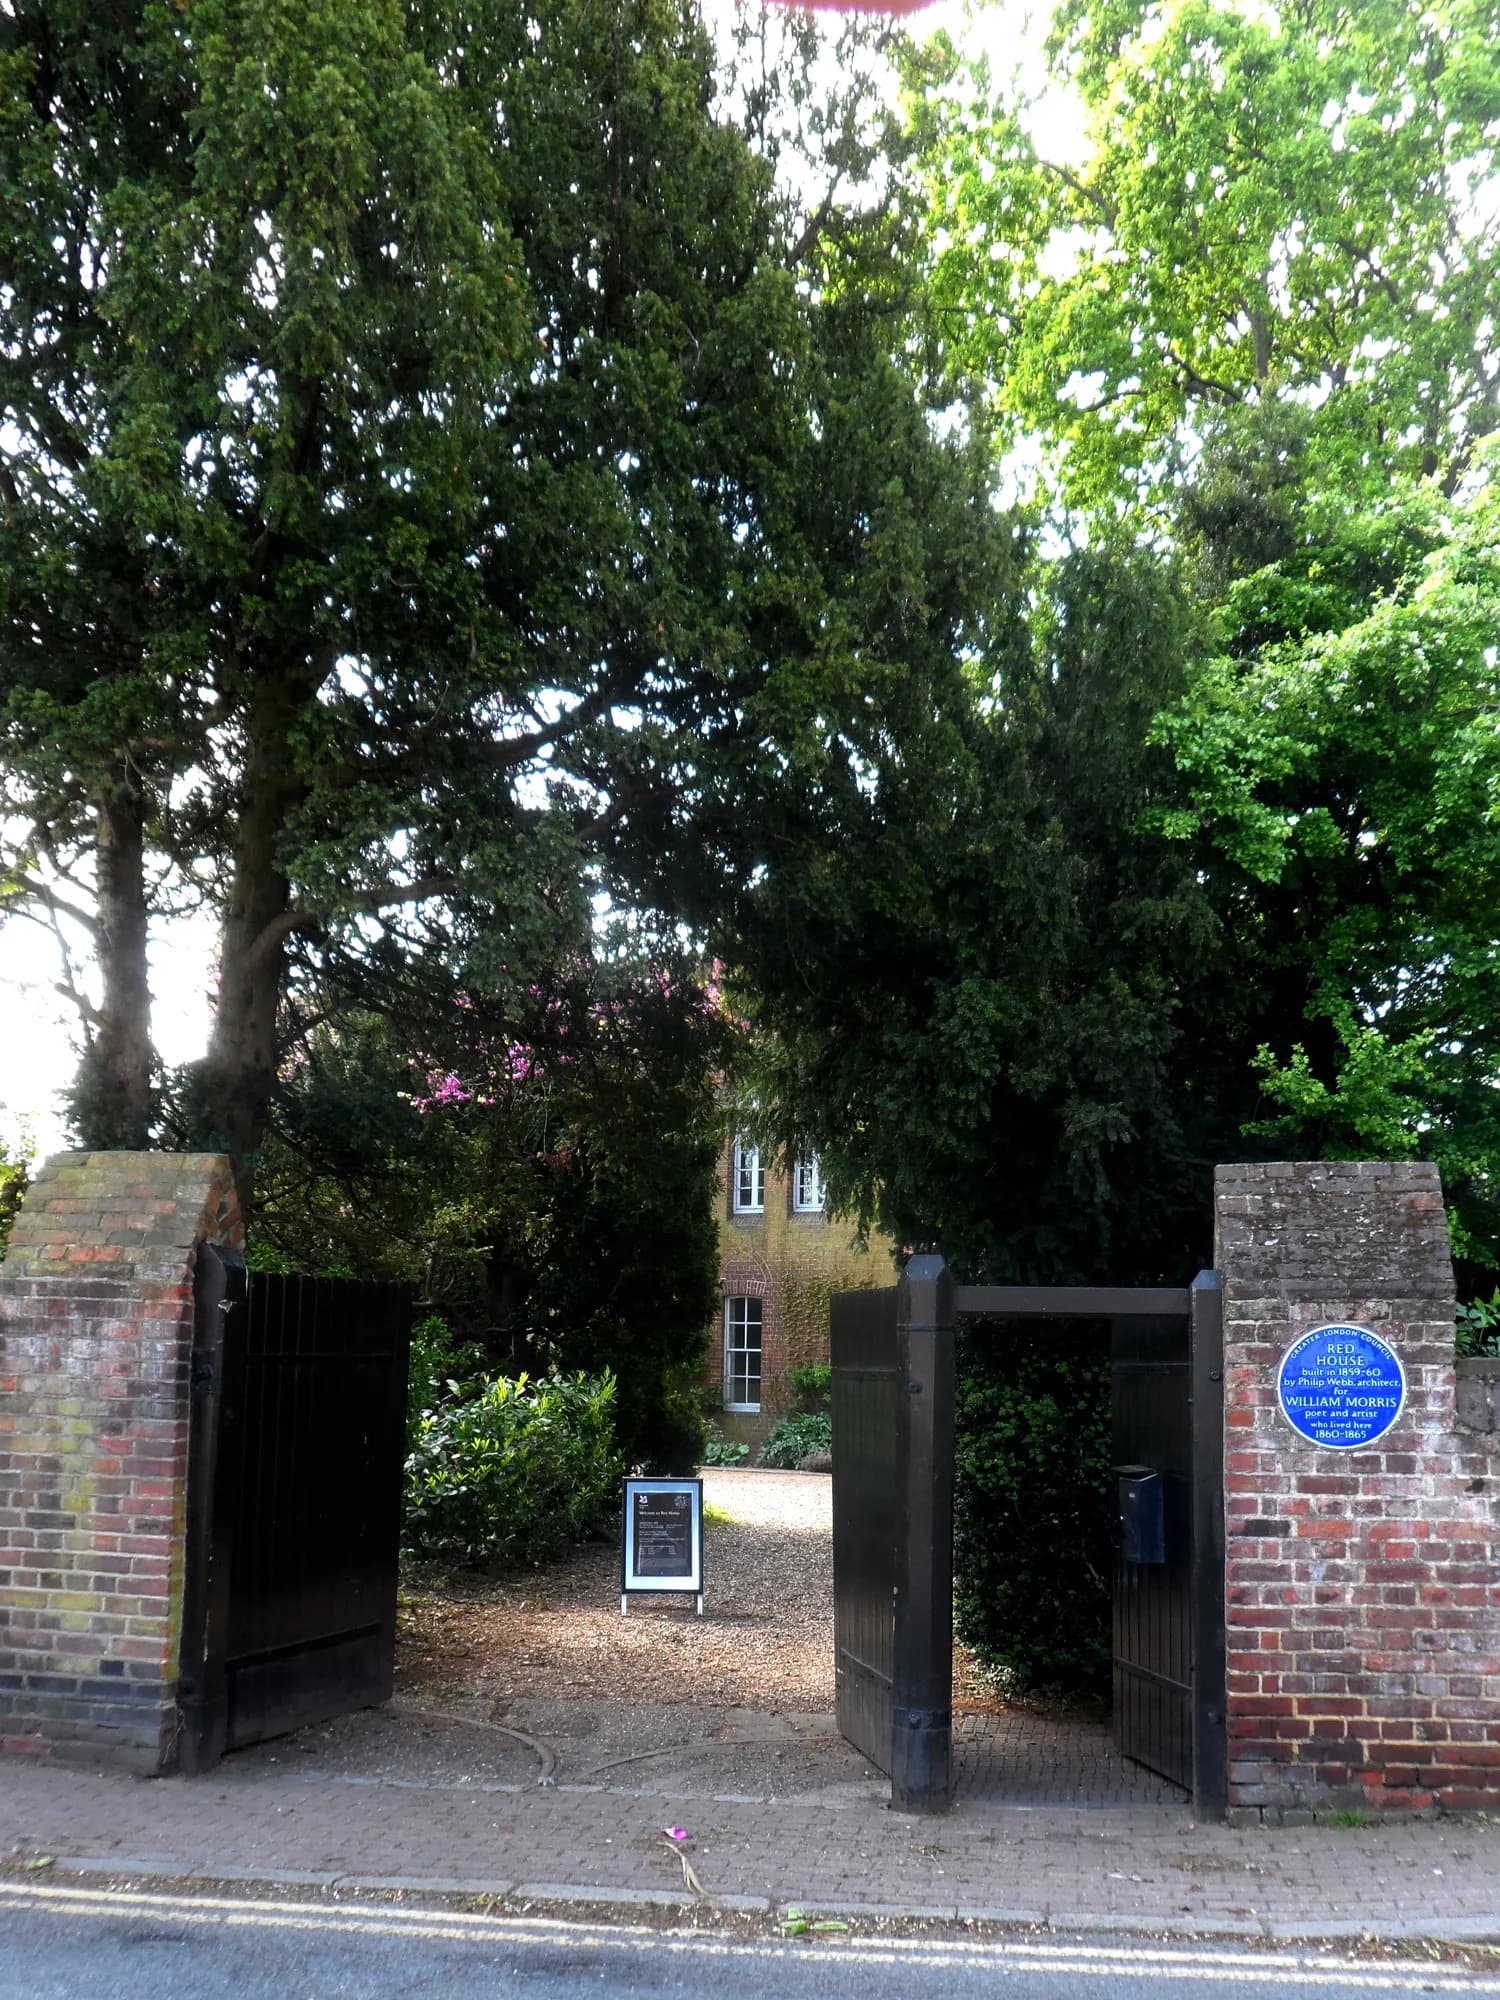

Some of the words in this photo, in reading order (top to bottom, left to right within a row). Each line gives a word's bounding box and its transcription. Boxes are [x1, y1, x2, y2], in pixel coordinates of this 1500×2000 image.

[1291, 1335, 1320, 1358] GREATER
[1323, 1329, 1358, 1337] LONDON
[1361, 1333, 1392, 1360] COUNCIL
[1327, 1344, 1355, 1354] RED
[1317, 1356, 1365, 1365] HOUSE
[1284, 1378, 1296, 1387] by
[1298, 1378, 1324, 1387] Philip
[1334, 1387, 1348, 1395] for
[1286, 1397, 1340, 1407] WILLIAM
[1346, 1397, 1397, 1407] MORRIS
[1305, 1410, 1327, 1418] poet
[1316, 1430, 1366, 1438] 1860-1865
